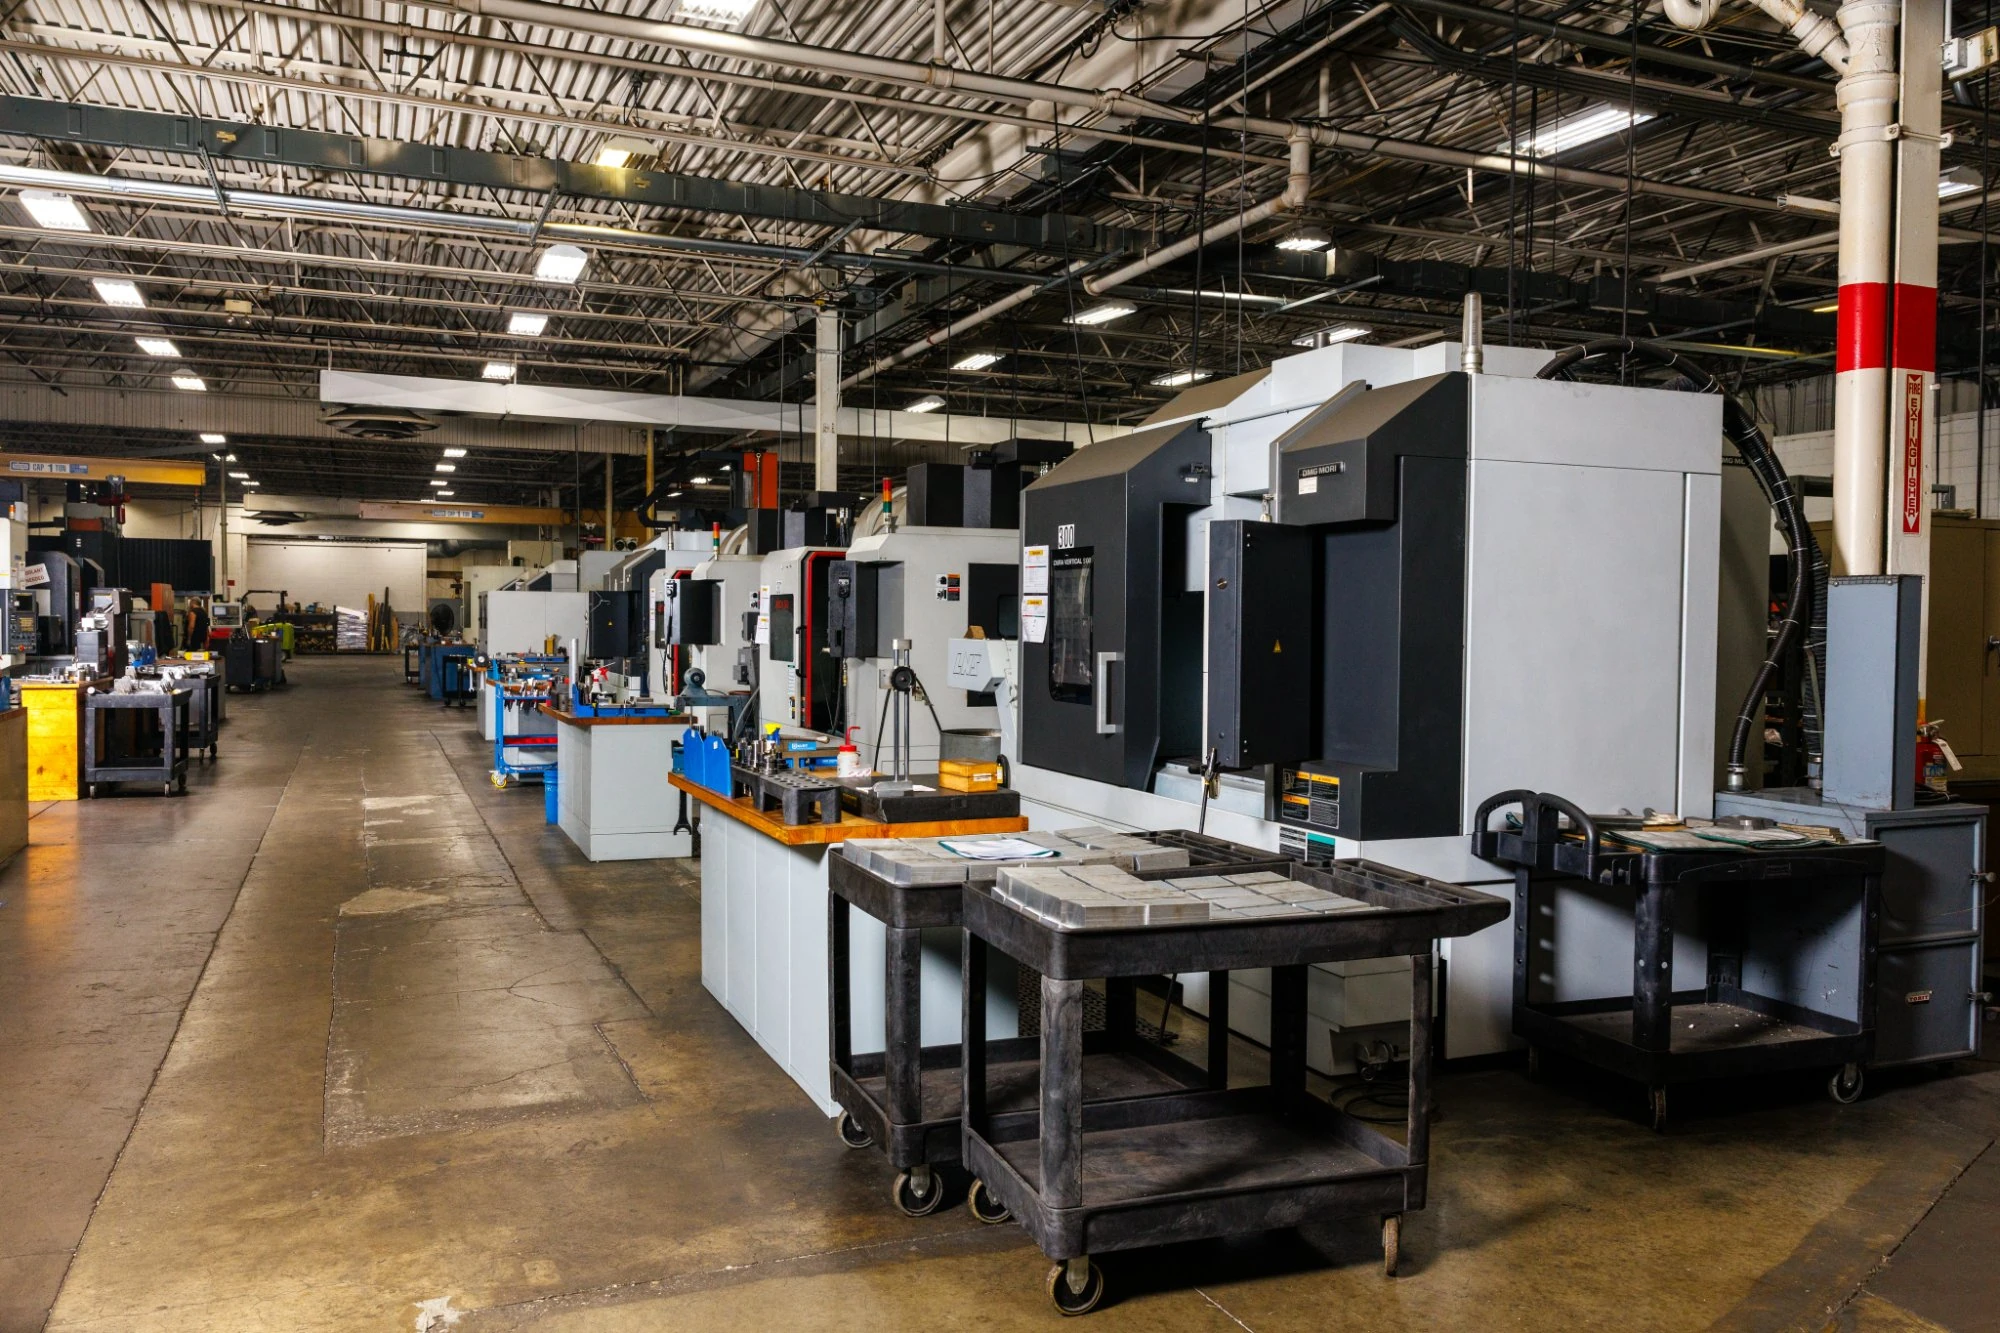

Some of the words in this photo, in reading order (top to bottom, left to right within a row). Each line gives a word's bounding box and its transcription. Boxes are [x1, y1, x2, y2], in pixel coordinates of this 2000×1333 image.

[1909, 383, 1920, 394] FIRE
[1908, 398, 1917, 517] EXTINGUISHER
[48, 464, 53, 472] 1
[1302, 468, 1318, 477] DMG
[1318, 464, 1337, 474] MORI
[1059, 526, 1074, 548] 300
